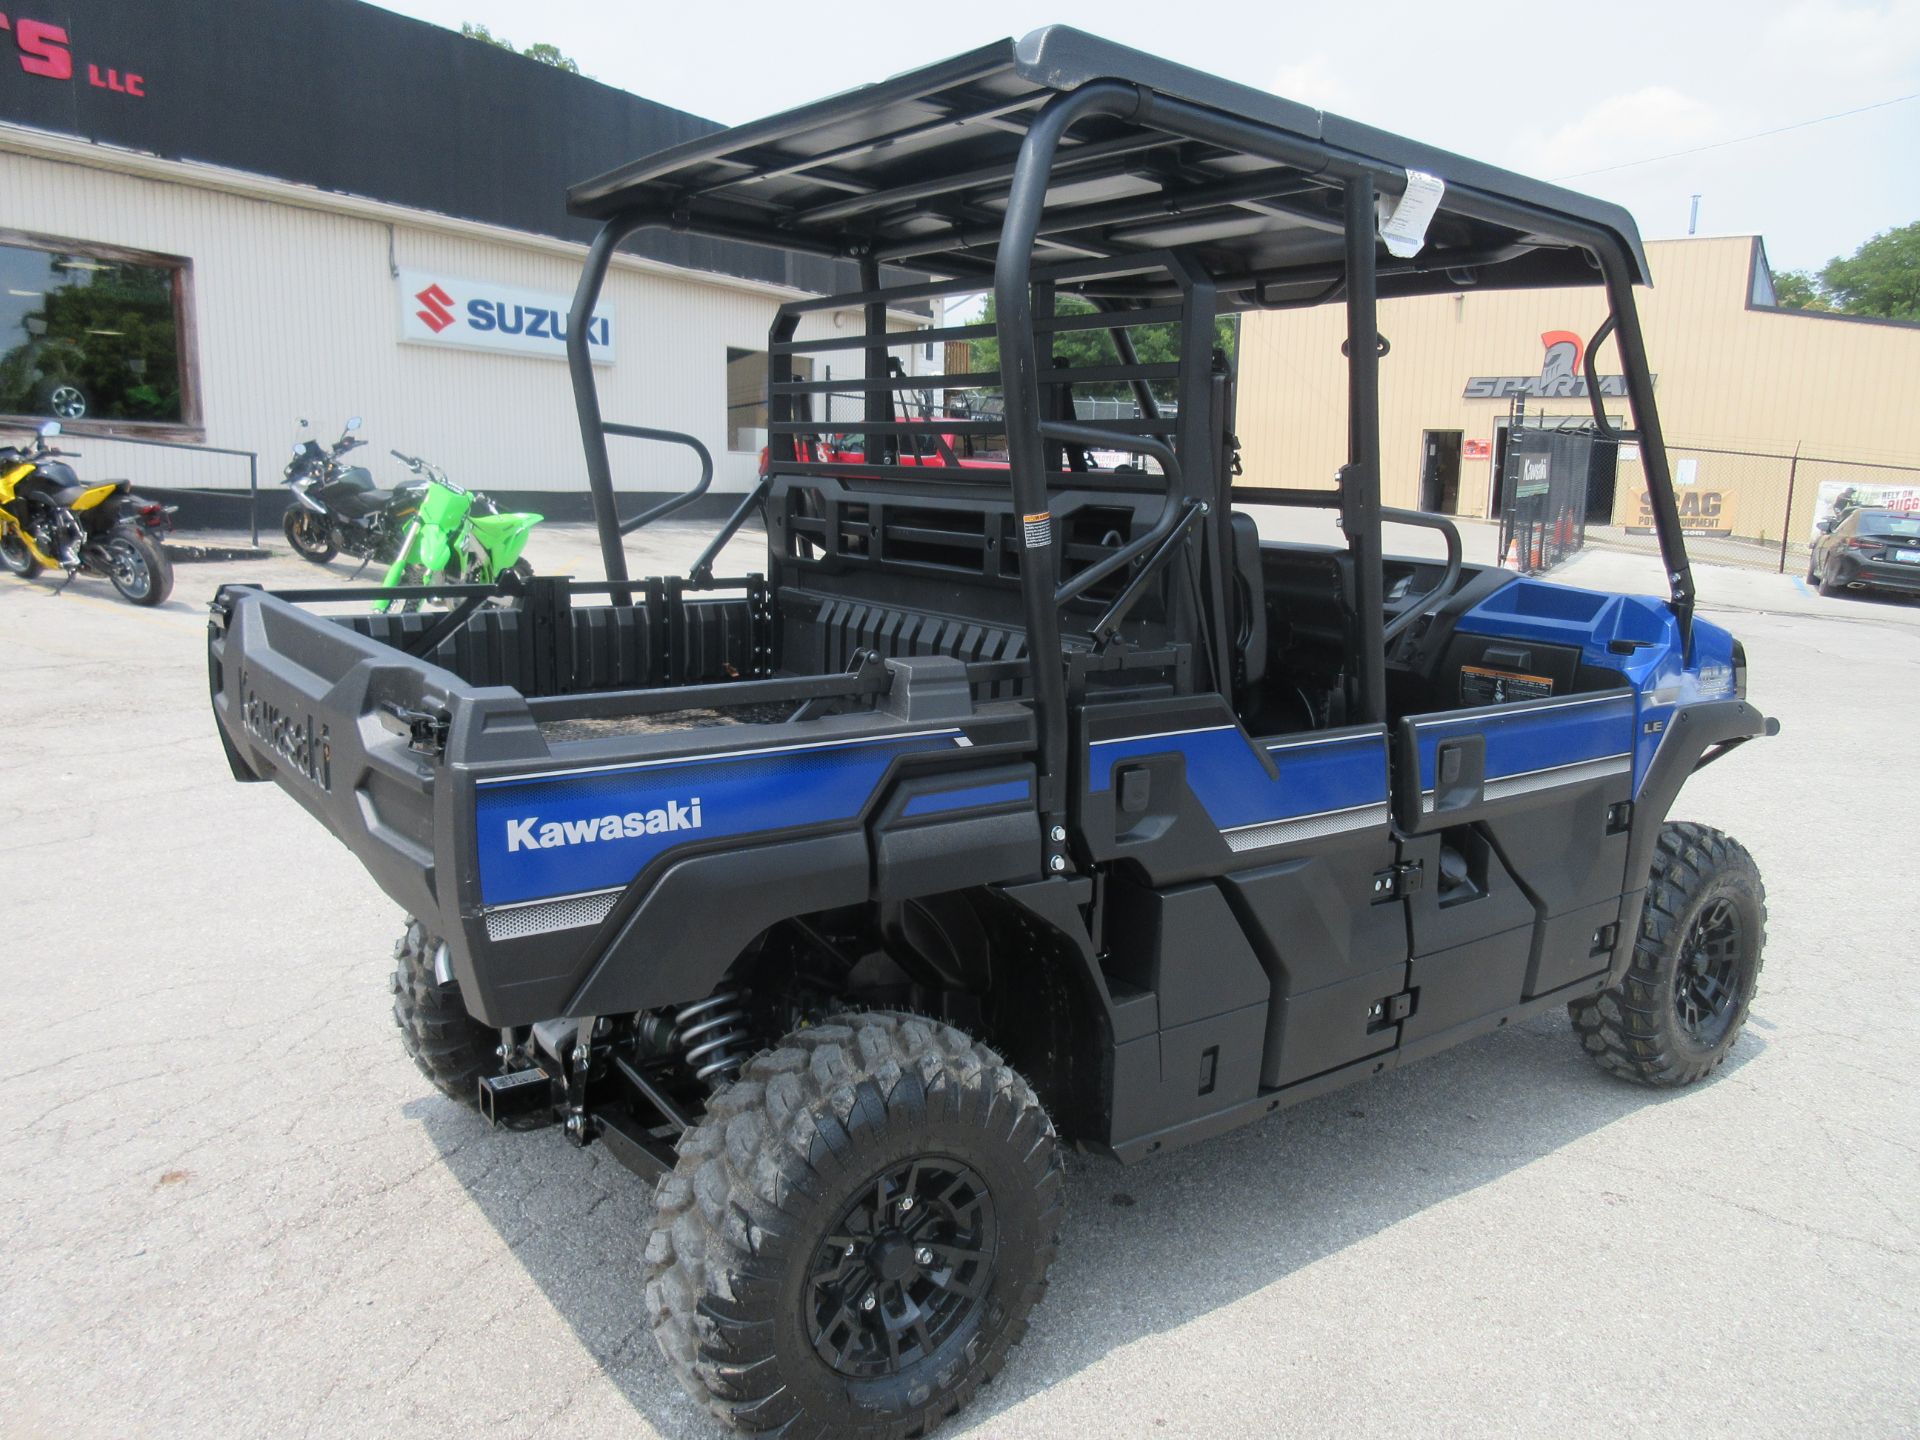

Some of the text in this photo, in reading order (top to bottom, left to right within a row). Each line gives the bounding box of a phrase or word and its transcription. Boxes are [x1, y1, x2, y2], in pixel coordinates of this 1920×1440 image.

[0, 11, 145, 97] S LLC
[1464, 374, 1656, 398] SPARTA
[238, 666, 332, 794] Kawasaki
[1644, 721, 1663, 734] LE
[507, 797, 702, 852] Kawasaki
